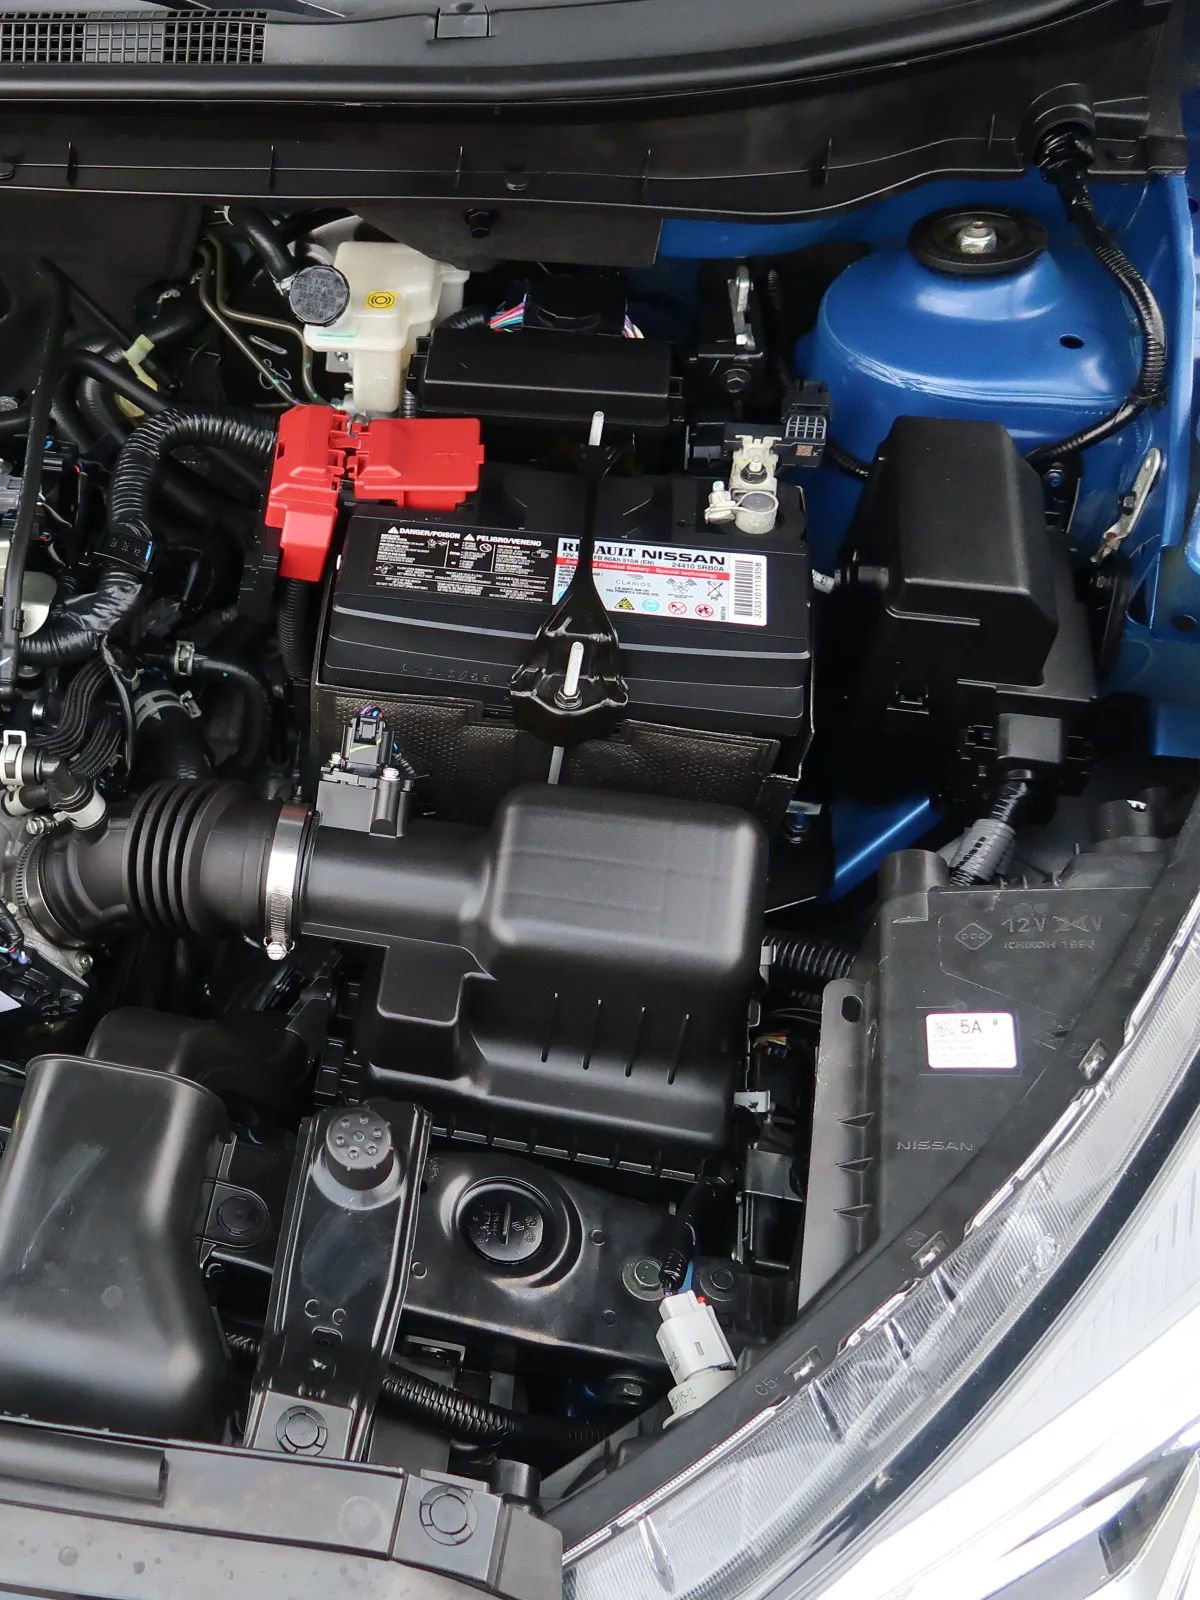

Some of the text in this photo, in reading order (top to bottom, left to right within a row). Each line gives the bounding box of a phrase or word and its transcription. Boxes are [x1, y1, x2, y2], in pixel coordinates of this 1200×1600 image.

[400, 527, 461, 539] DANGER/POISON
[476, 535, 542, 547] PELIGRO/VENENO
[562, 542, 725, 565] RAULT NISSAN
[615, 579, 652, 588] CLARIOS
[1001, 917, 1046, 933] 12V
[960, 1019, 983, 1035] 5A
[897, 1140, 974, 1152] NISSAN
